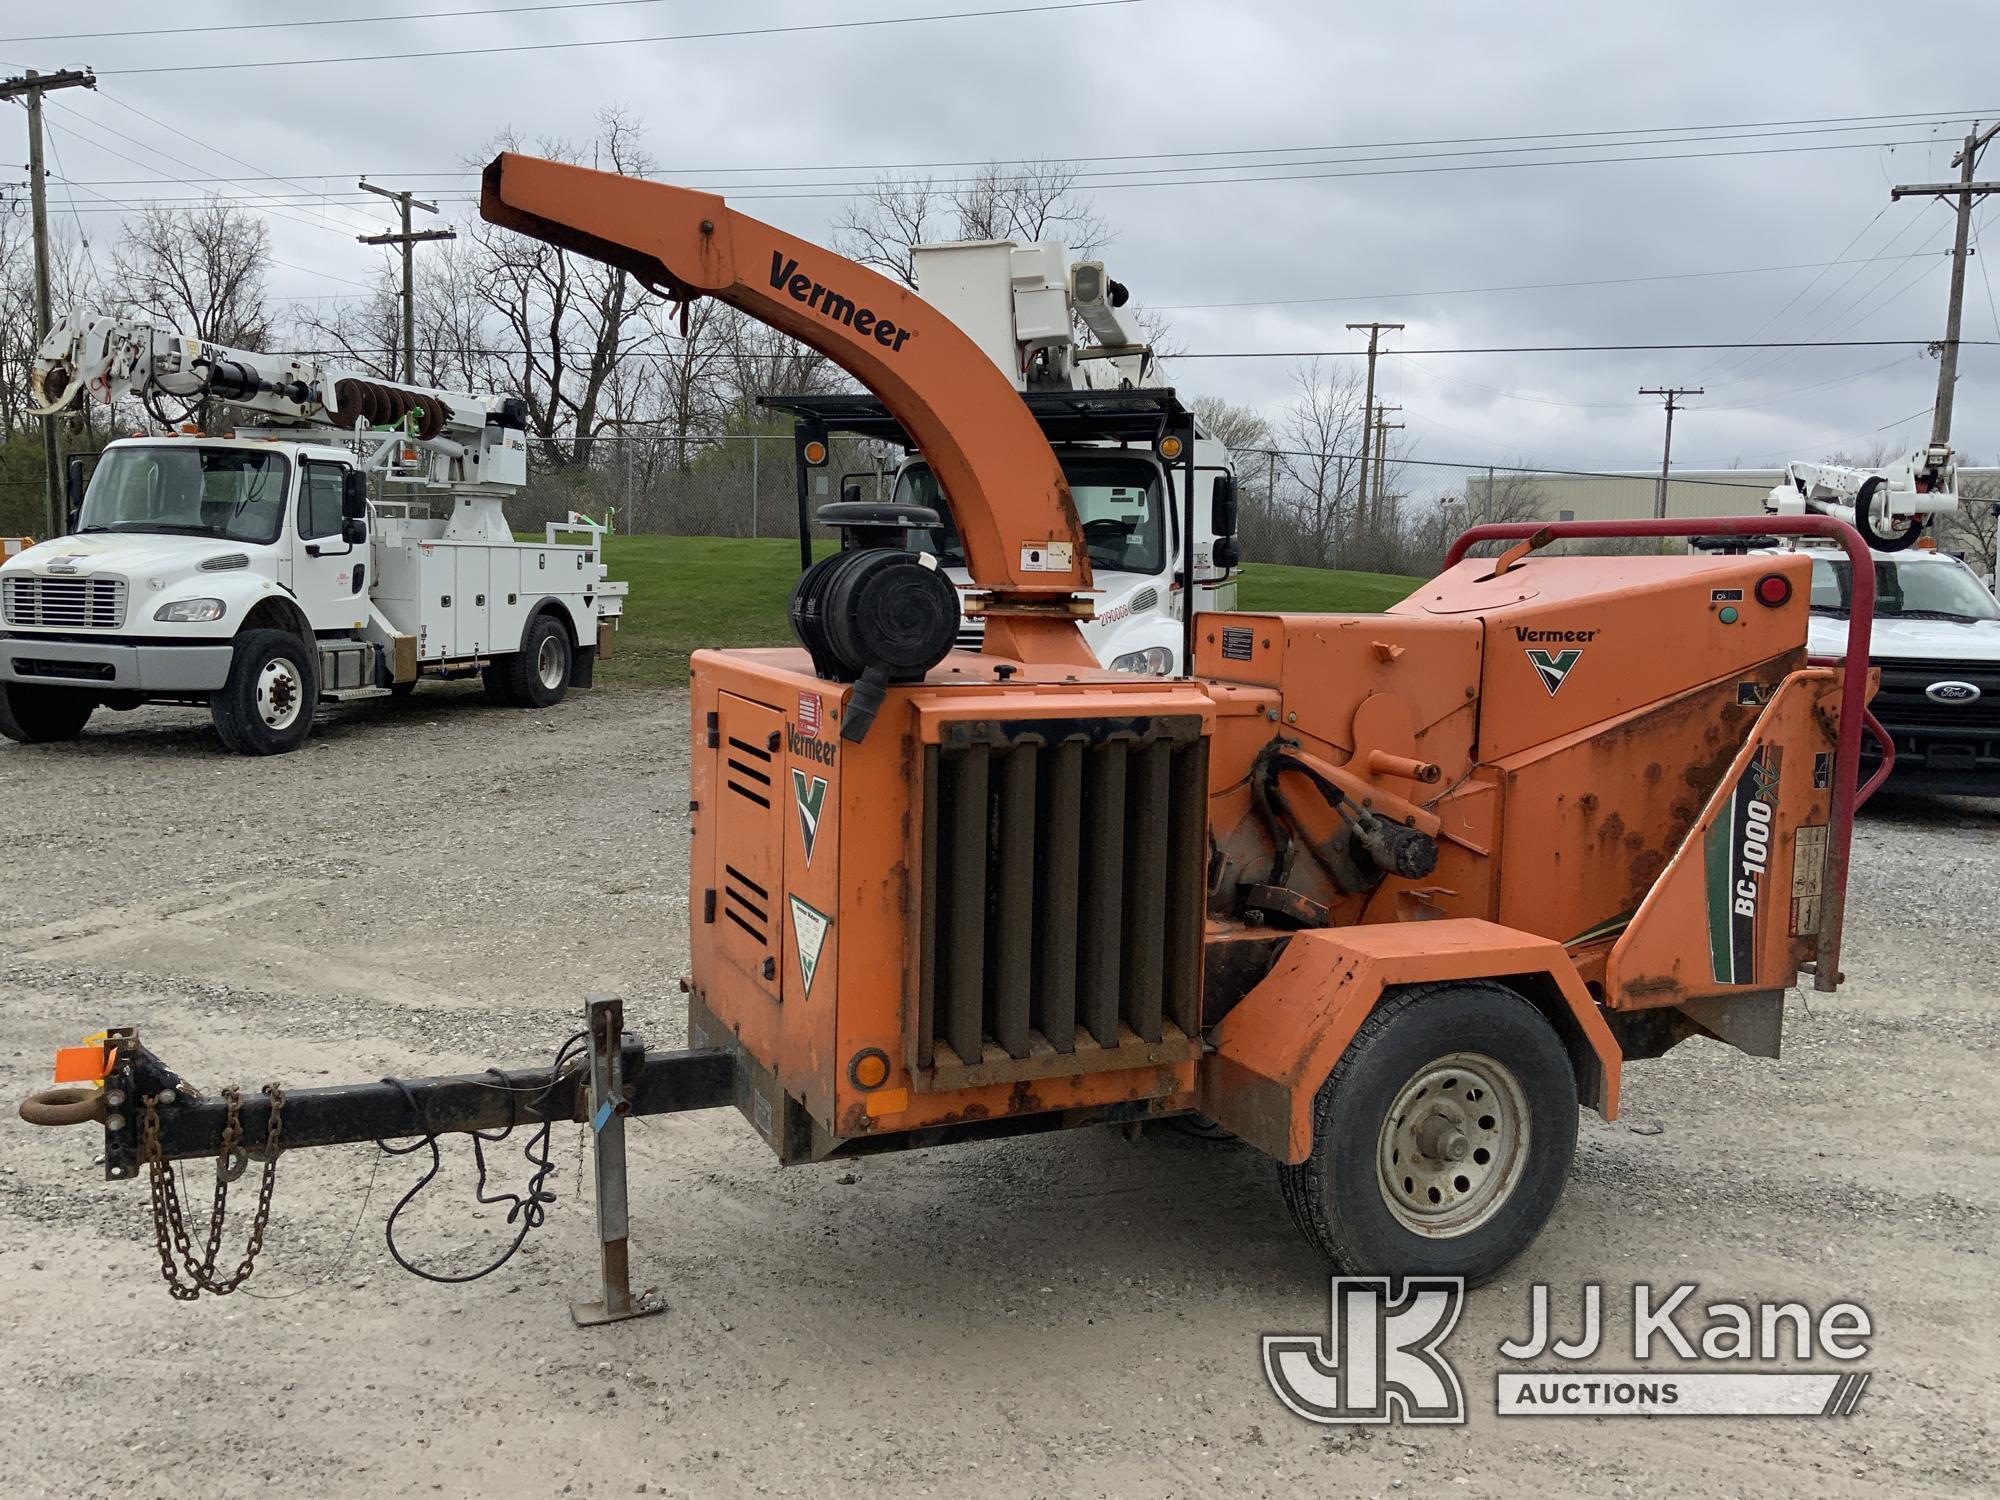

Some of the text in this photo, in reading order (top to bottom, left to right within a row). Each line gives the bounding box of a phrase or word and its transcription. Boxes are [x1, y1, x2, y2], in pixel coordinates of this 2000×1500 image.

[769, 249, 911, 352] Vermeer
[1515, 626, 1596, 642] Vermeer
[1940, 686, 1967, 698] Ford
[786, 721, 837, 768] Vermeer
